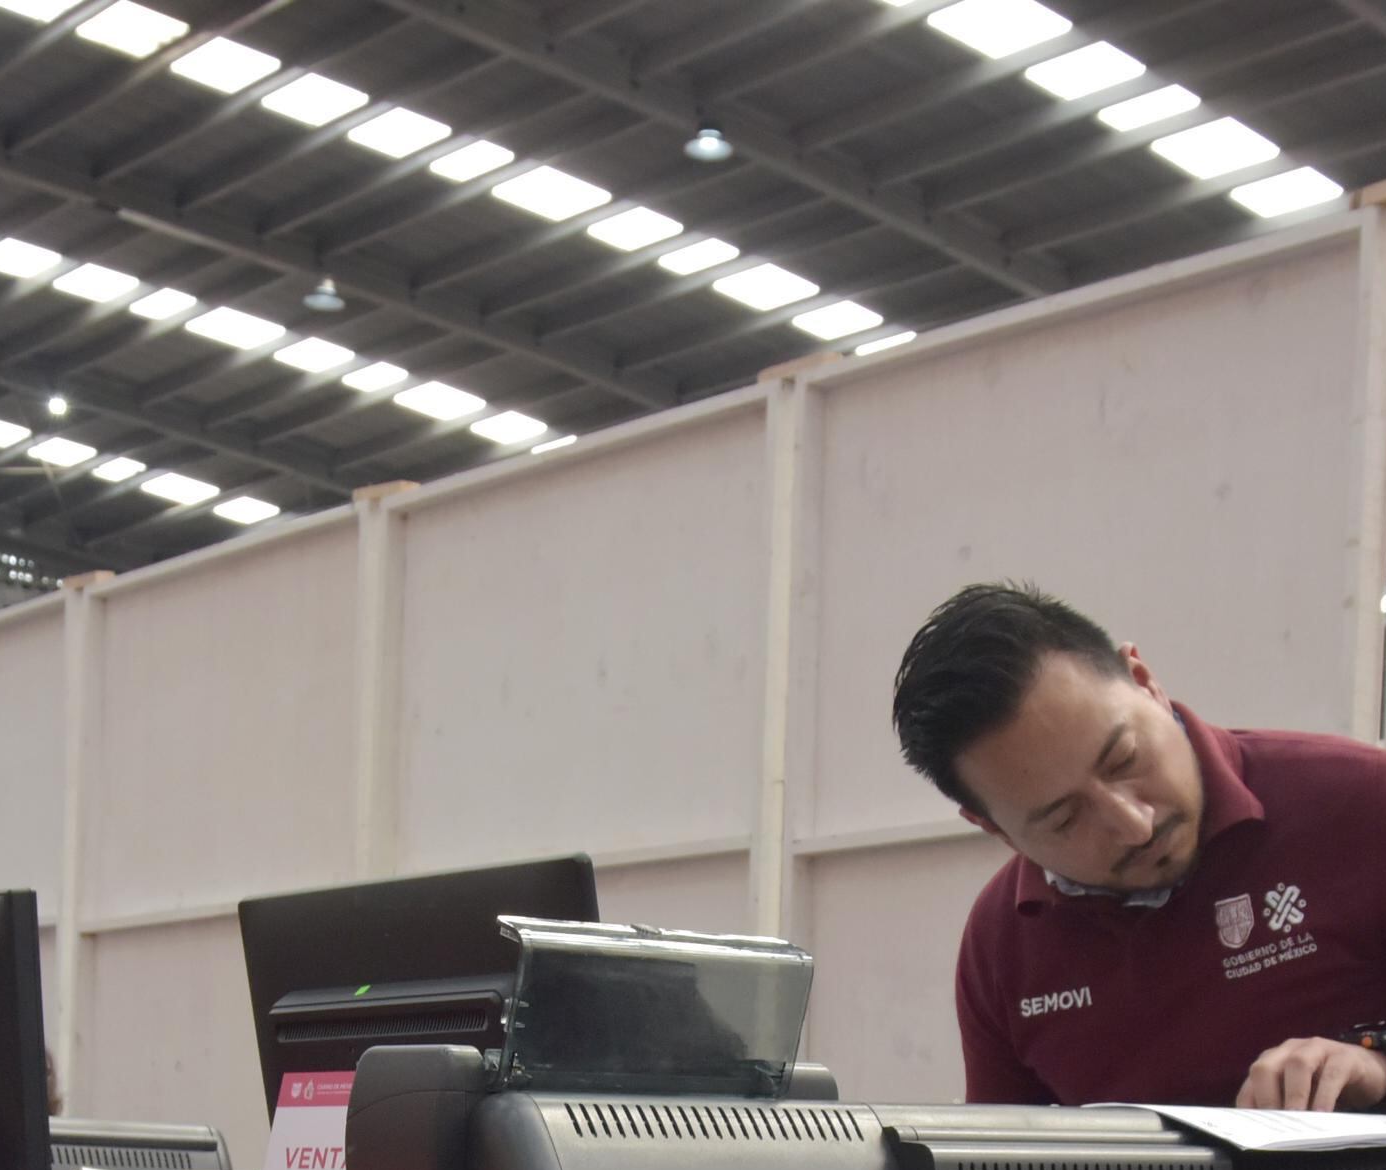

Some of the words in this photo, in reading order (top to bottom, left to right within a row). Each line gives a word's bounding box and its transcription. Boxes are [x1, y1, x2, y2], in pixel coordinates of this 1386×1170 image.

[1223, 943, 1277, 968] GOBIERNO
[1279, 937, 1295, 949] DE
[1297, 932, 1314, 944] LA
[1225, 962, 1262, 979] CIUDAD
[1263, 957, 1277, 968] DE
[1278, 943, 1317, 962] MÉXICO
[1020, 986, 1092, 1017] SEMOVI
